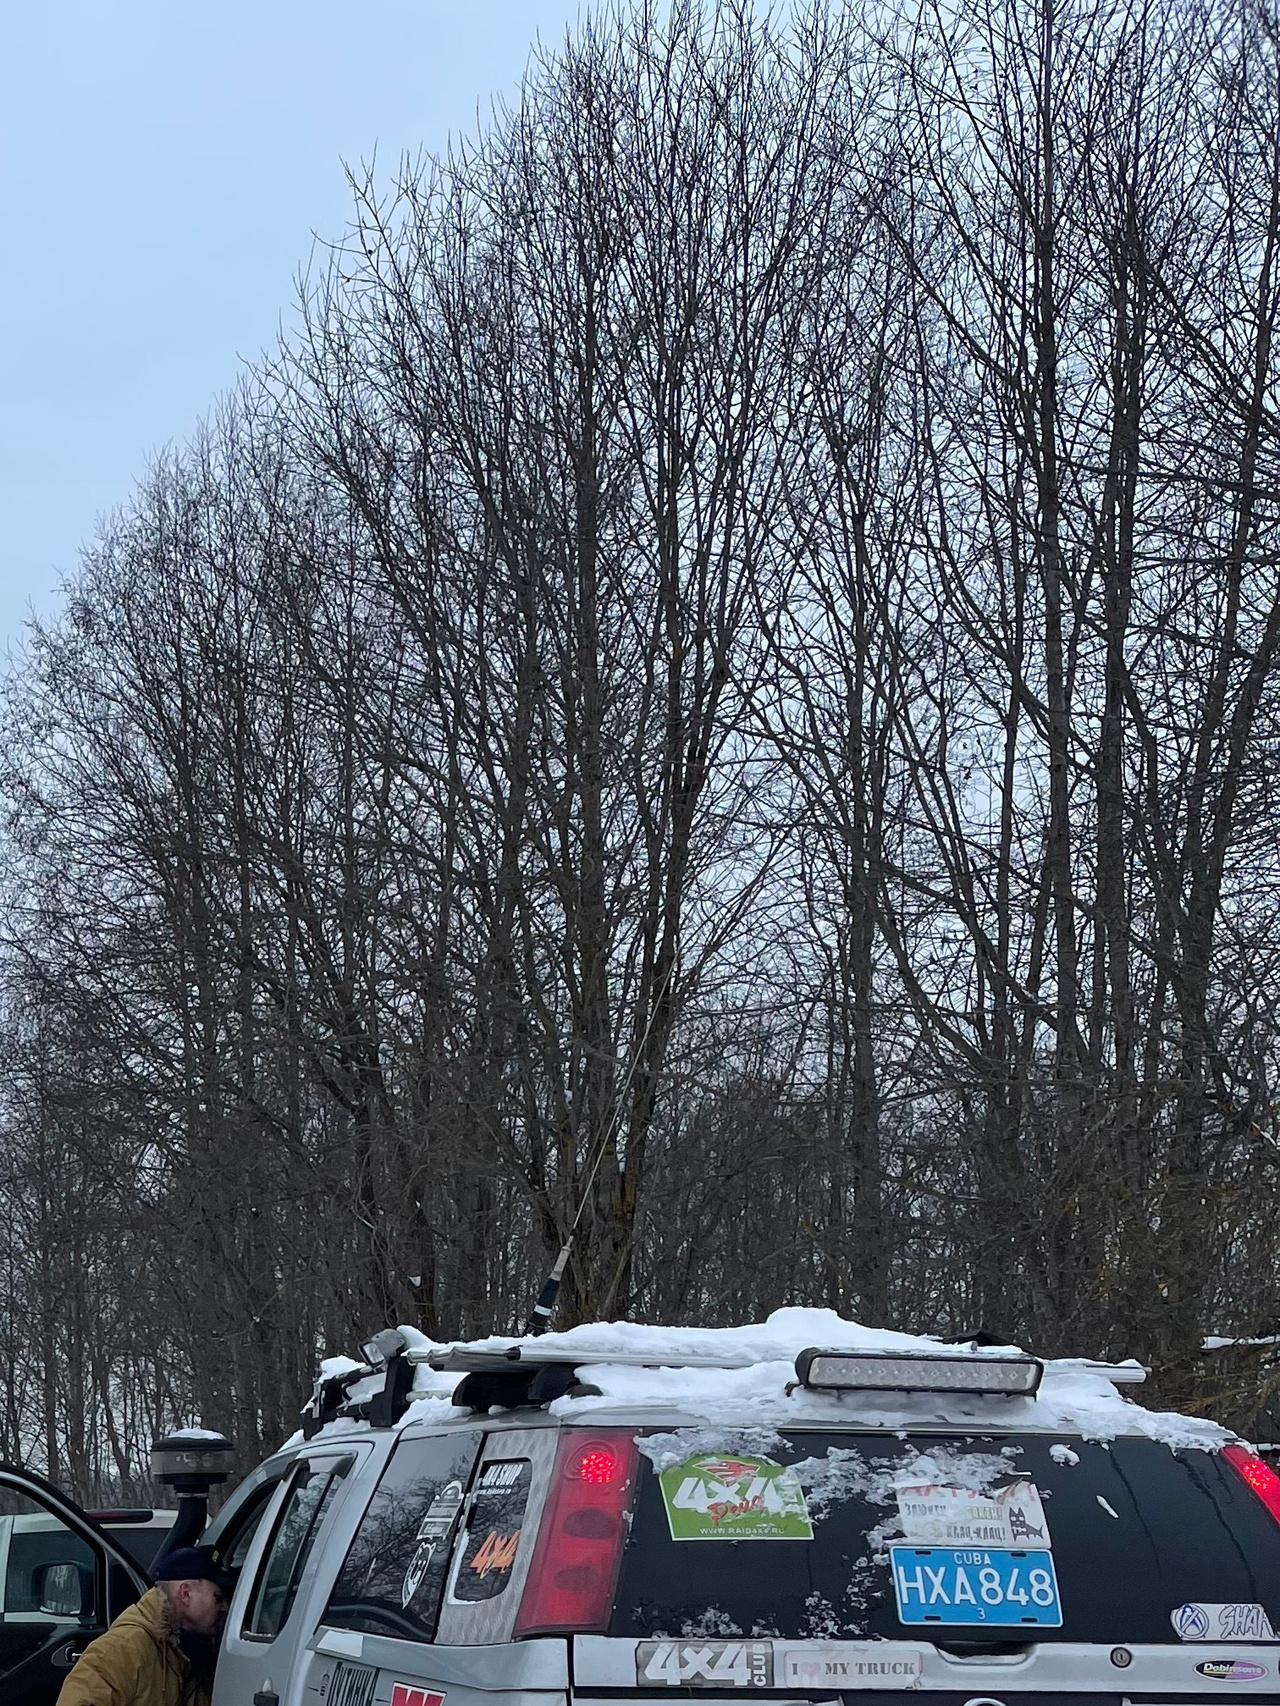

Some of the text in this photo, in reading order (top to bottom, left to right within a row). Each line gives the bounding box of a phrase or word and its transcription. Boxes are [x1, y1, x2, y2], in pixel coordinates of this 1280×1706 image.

[953, 1552, 992, 1566] CUBA
[897, 1565, 1055, 1607] HXA848
[976, 1607, 987, 1621] 3
[752, 1643, 767, 1687] CLUB
[792, 1661, 916, 1676] I MY TRUCK
[1203, 1662, 1263, 1675] Dobinsons
